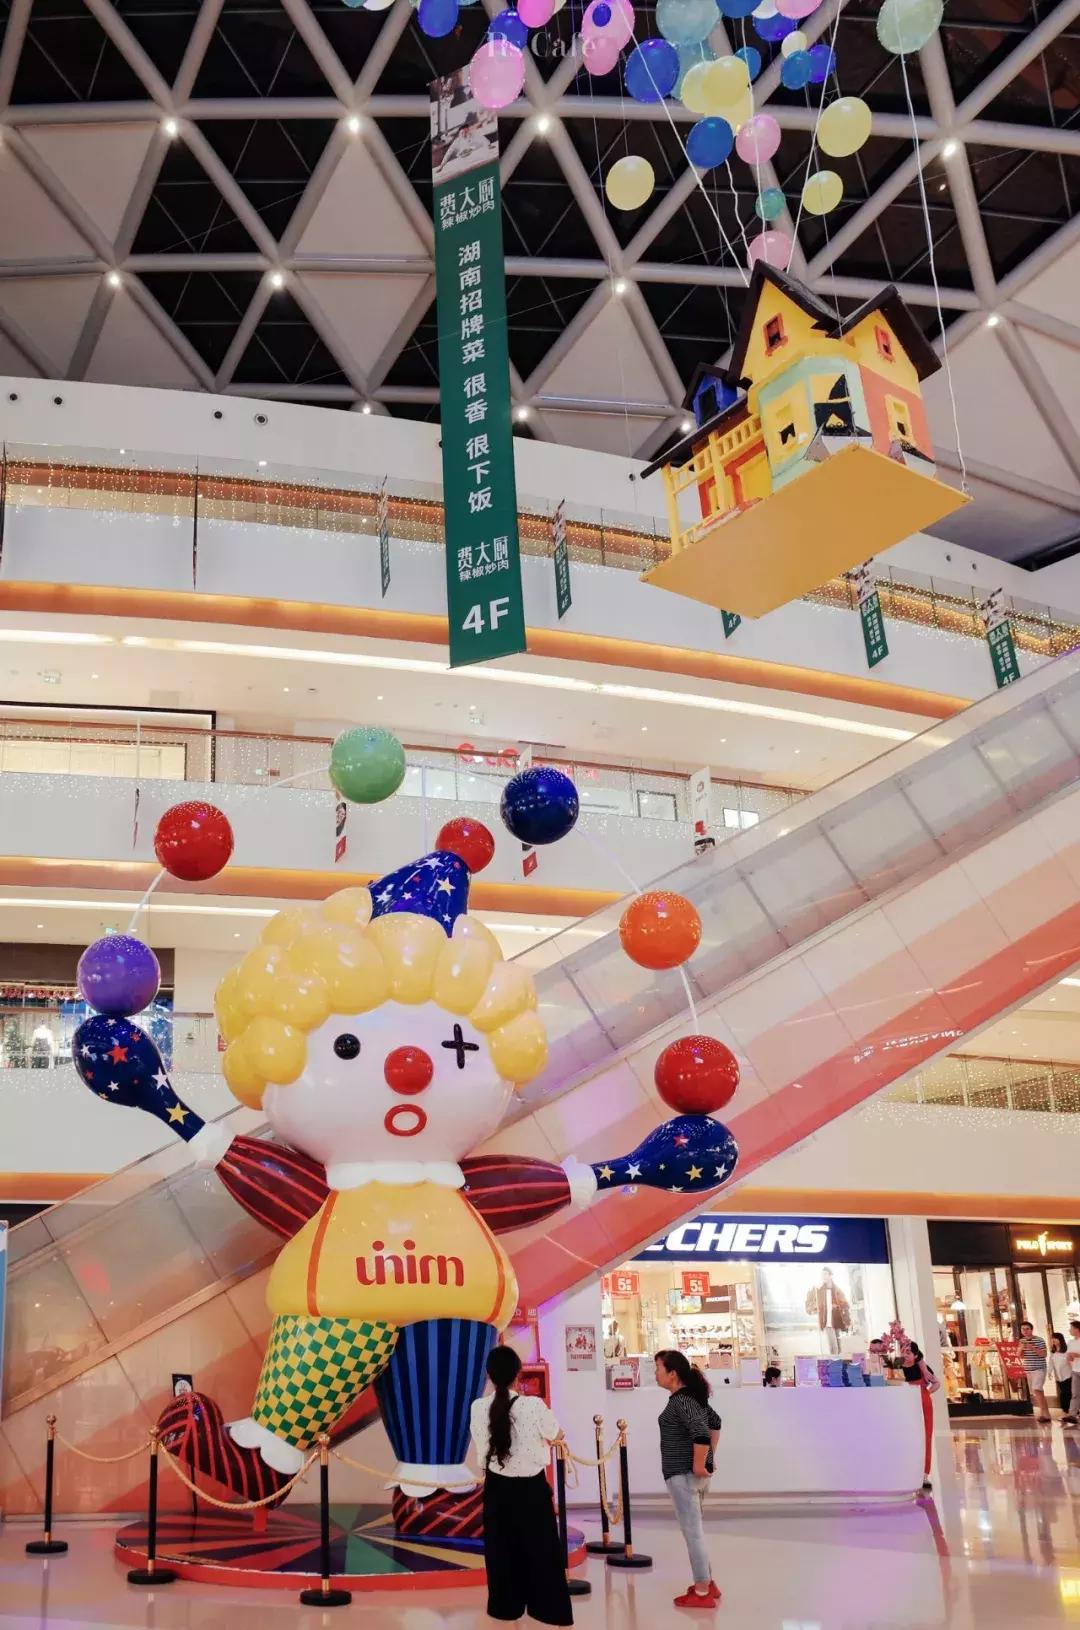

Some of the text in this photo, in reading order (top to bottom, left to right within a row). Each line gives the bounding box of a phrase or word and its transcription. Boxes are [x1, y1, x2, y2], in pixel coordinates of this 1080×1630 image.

[440, 176, 495, 220] 费大厨
[441, 199, 495, 231] 辣椒炒肉
[458, 240, 493, 514] 湖南招牌菜 很香 很下饭
[457, 535, 509, 571] 费大厨
[459, 559, 509, 582] 辣椒炒肉
[462, 596, 510, 635] 4F
[871, 644, 884, 659] 4F
[1002, 671, 1016, 685] 4F
